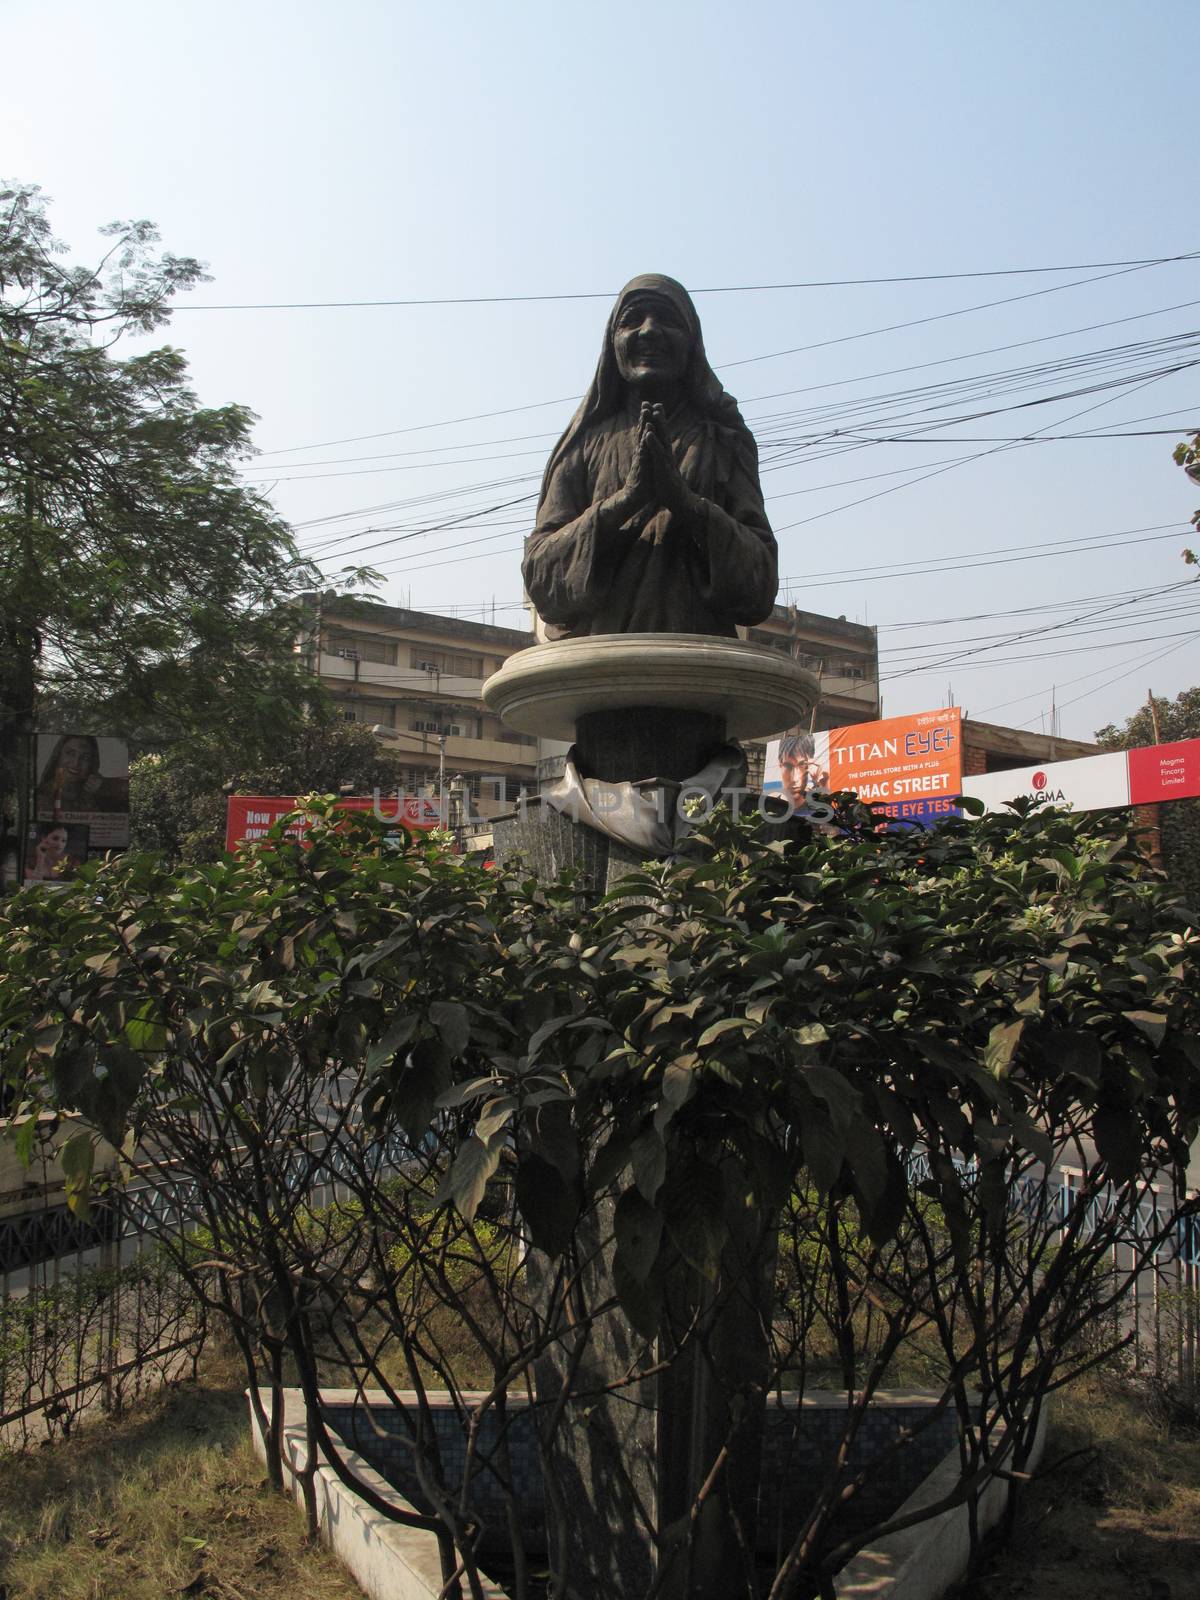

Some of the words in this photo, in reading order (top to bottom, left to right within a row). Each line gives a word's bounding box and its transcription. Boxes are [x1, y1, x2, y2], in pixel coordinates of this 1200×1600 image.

[833, 738, 898, 765] TITAN
[859, 768, 882, 778] OPTICAL
[883, 766, 902, 775] STORE
[902, 764, 919, 773] WITH
[924, 760, 940, 769] PLUS
[1160, 757, 1184, 767] Magma
[1161, 767, 1185, 777] Fincorp
[893, 773, 950, 795] STREET
[1161, 776, 1185, 786] Limited
[1017, 788, 1066, 803] AGMA
[902, 802, 924, 816] EYE
[246, 810, 270, 825] Now
